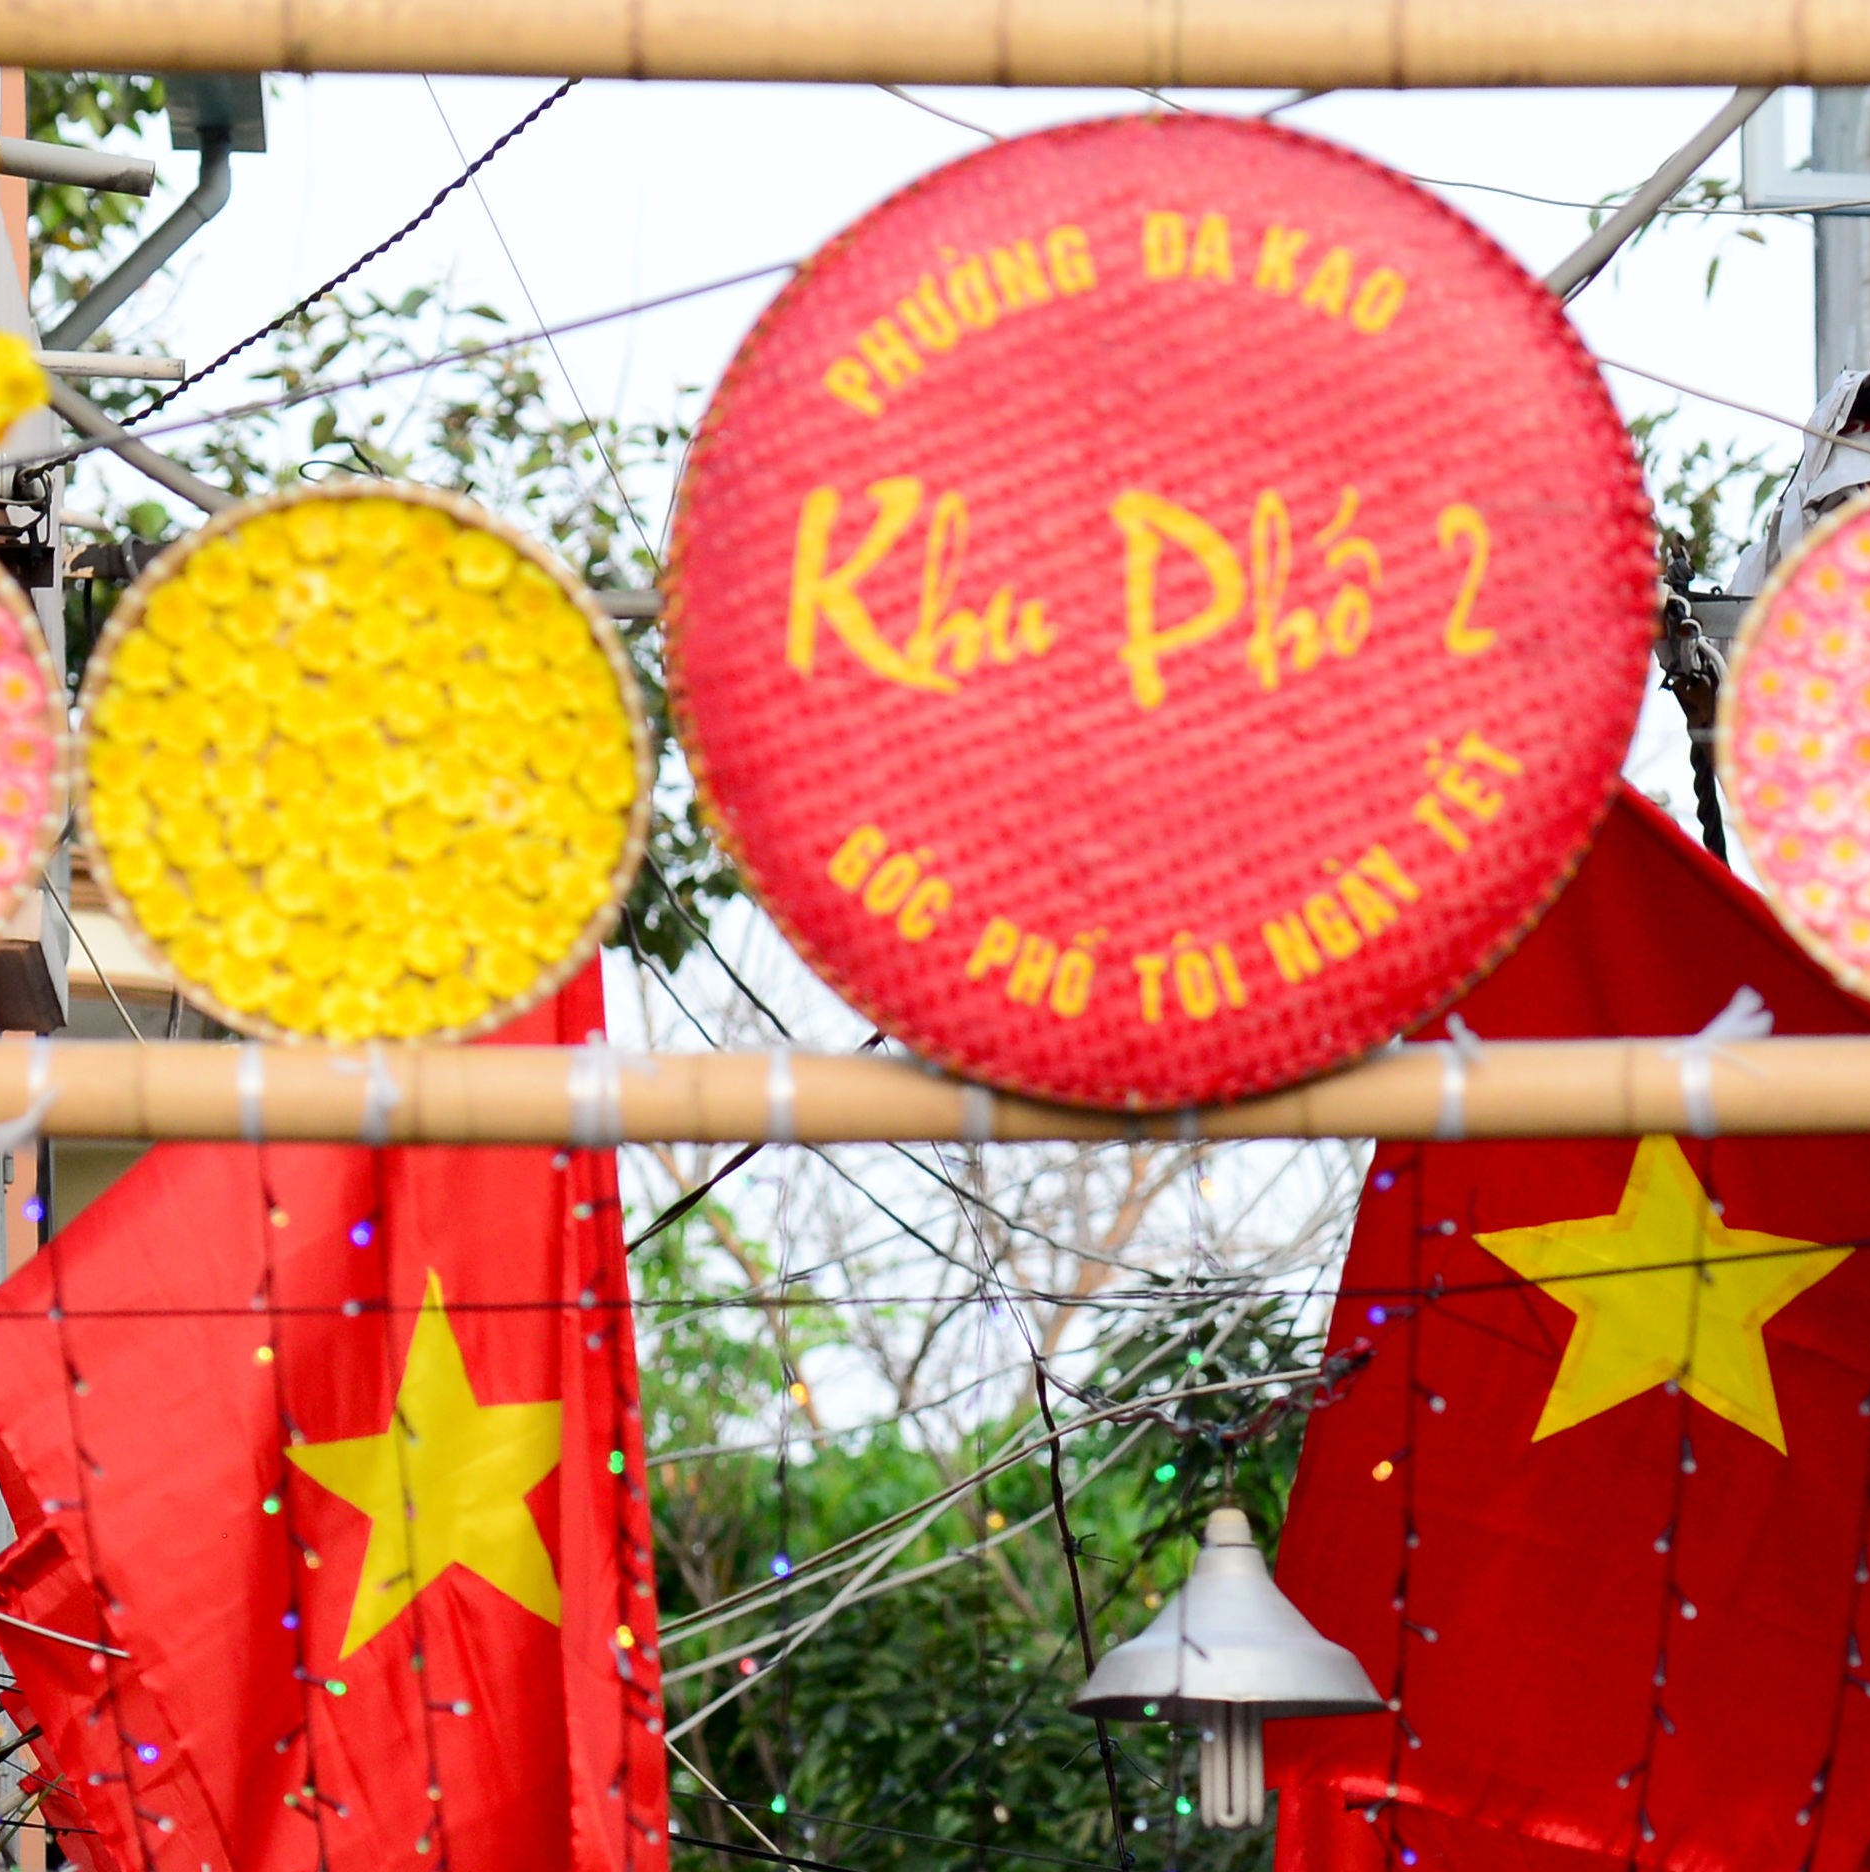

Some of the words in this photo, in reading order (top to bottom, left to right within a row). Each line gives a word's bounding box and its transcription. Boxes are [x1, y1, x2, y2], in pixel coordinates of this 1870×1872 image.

[821, 224, 1097, 419] PHƯỜNG
[1255, 224, 1407, 336] KAO
[786, 476, 1057, 693] Khu
[1110, 485, 1382, 709] Phố
[1439, 503, 1497, 656] 2
[1134, 930, 1247, 1024] TÔI
[1262, 843, 1421, 985] NGÀY
[1412, 730, 1523, 853] TẾT
